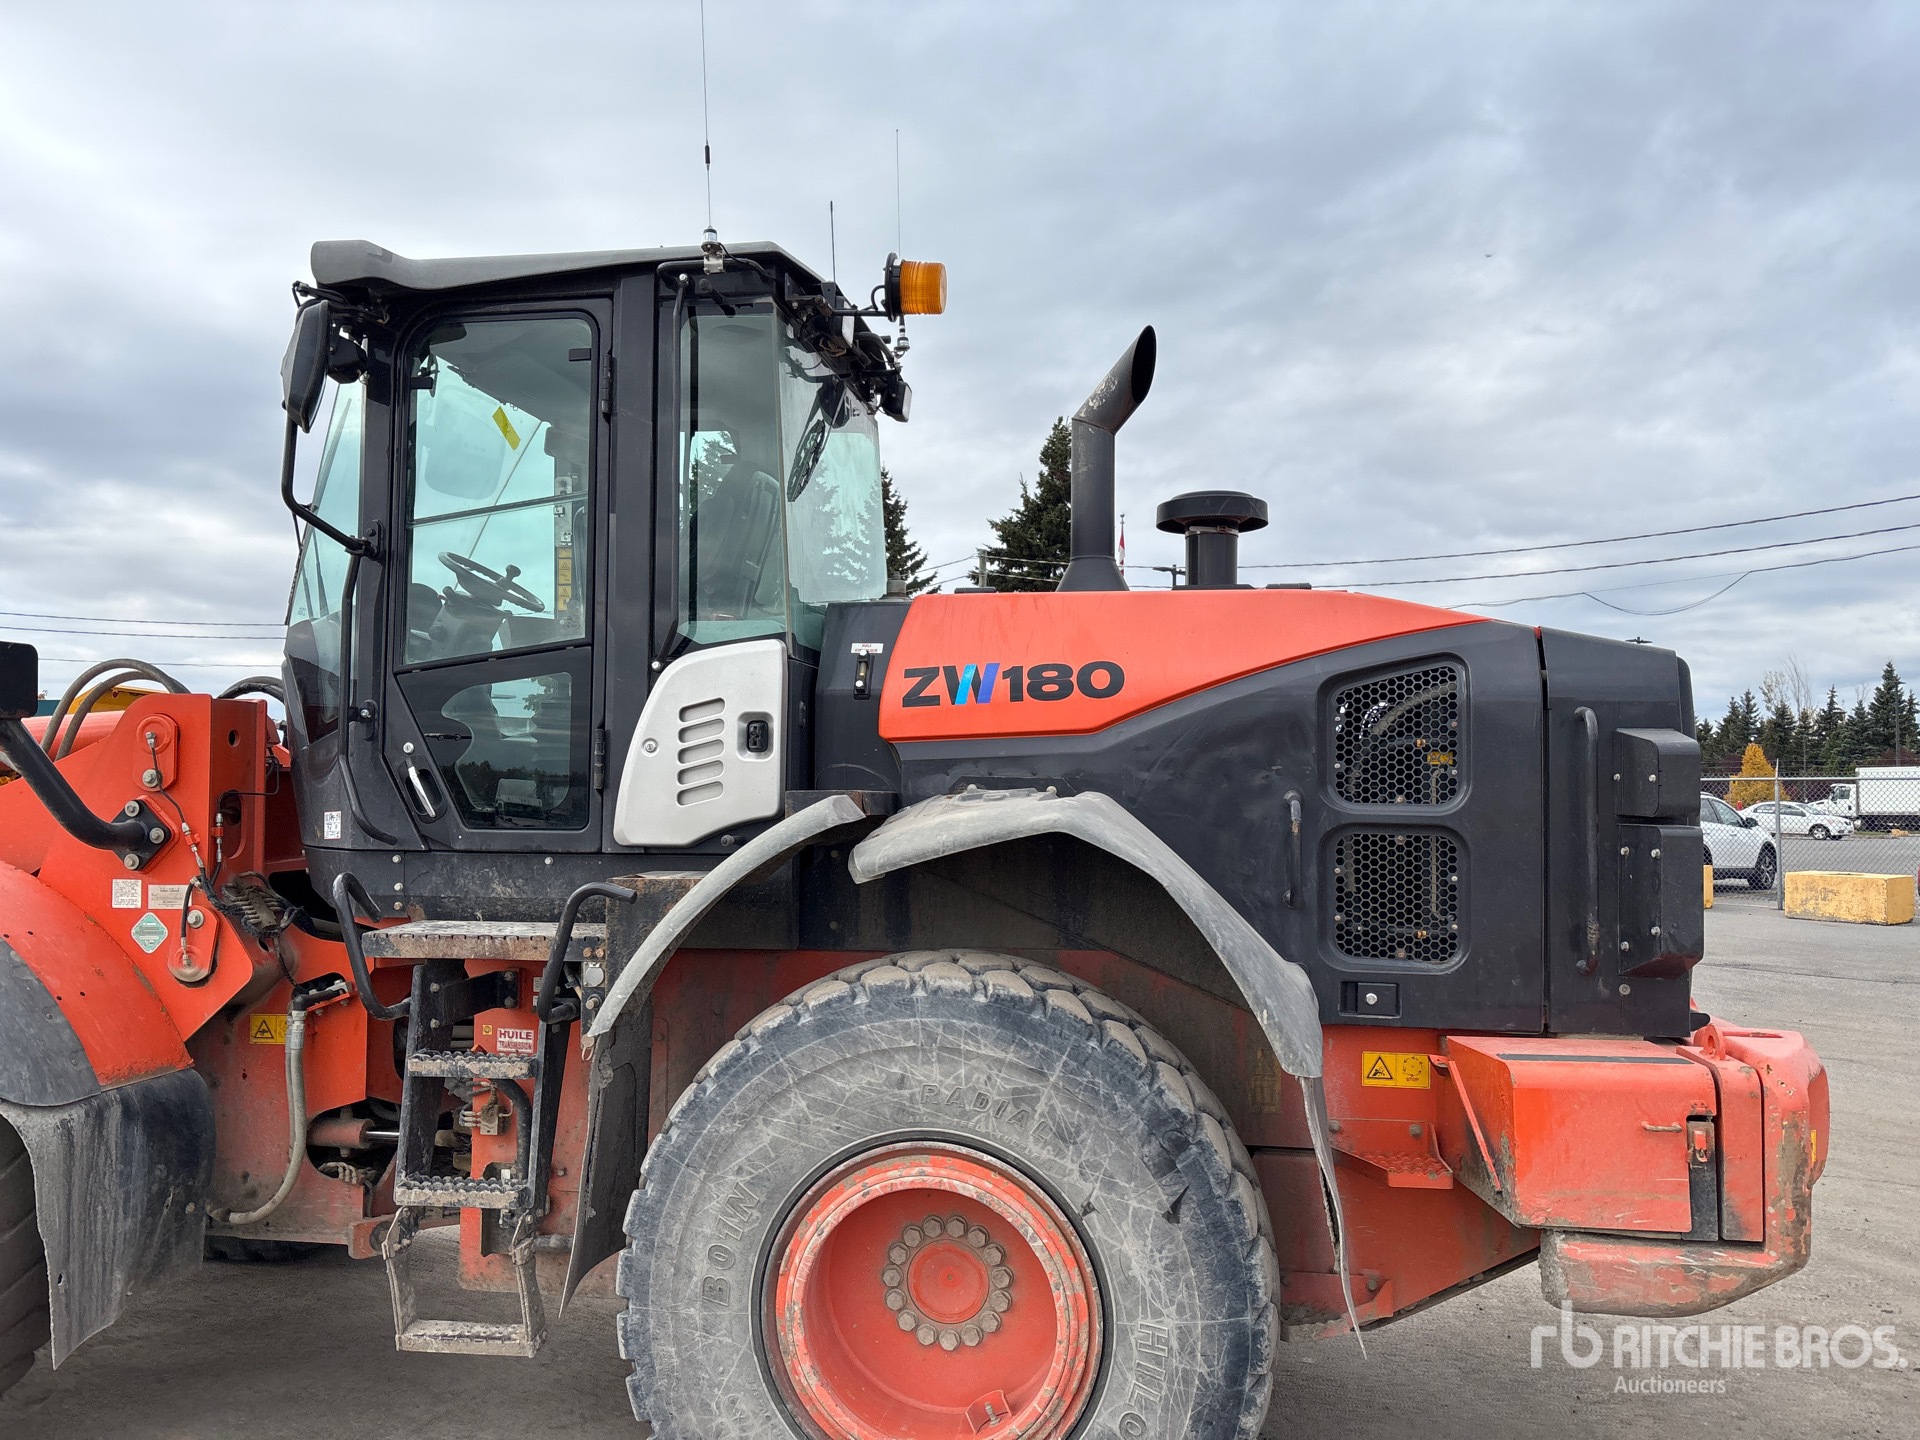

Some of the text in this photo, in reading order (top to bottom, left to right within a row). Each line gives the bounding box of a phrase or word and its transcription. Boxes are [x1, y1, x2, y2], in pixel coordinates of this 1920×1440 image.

[902, 661, 1125, 708] ZW180
[498, 1040, 532, 1050] TRANSMISSION
[499, 1030, 532, 1040] HUILE
[920, 1083, 1051, 1142] RADIAL
[1119, 1321, 1168, 1440] HILO
